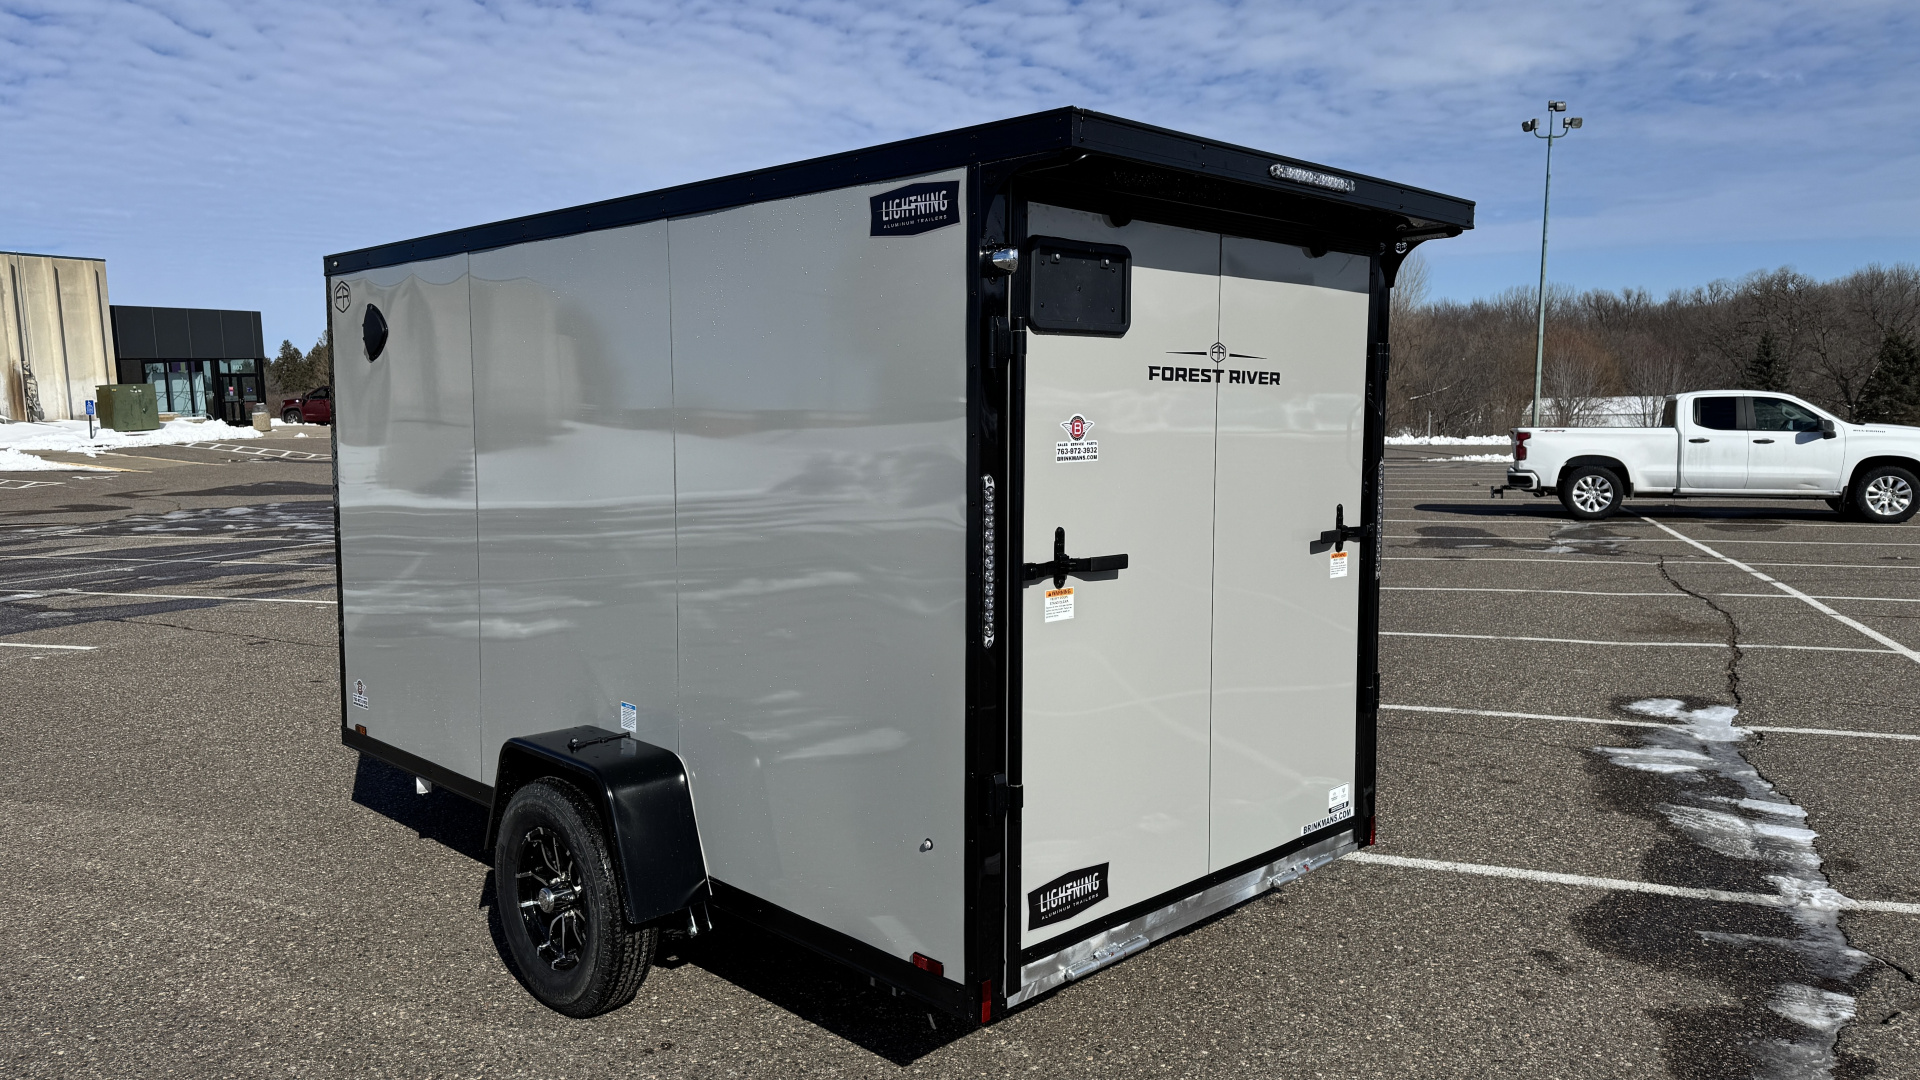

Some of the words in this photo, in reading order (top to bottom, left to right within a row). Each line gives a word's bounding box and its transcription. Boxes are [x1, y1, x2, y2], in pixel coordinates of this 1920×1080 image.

[882, 190, 948, 221] LIGHTNING
[883, 220, 915, 229] ALUMINUM
[917, 215, 948, 223] TRAILERS
[1148, 366, 1225, 383] FOREST
[1228, 370, 1281, 385] RIVER
[1074, 422, 1082, 435] B
[1056, 454, 1098, 462] BRINKMANS.COM
[1057, 446, 1098, 455] 763-972-3932
[1303, 808, 1352, 835] BRINKMANS.COM
[1040, 872, 1100, 913] LIGHTNING
[1041, 904, 1071, 920] ALUMINUM
[1072, 893, 1099, 907] TRAILERS
